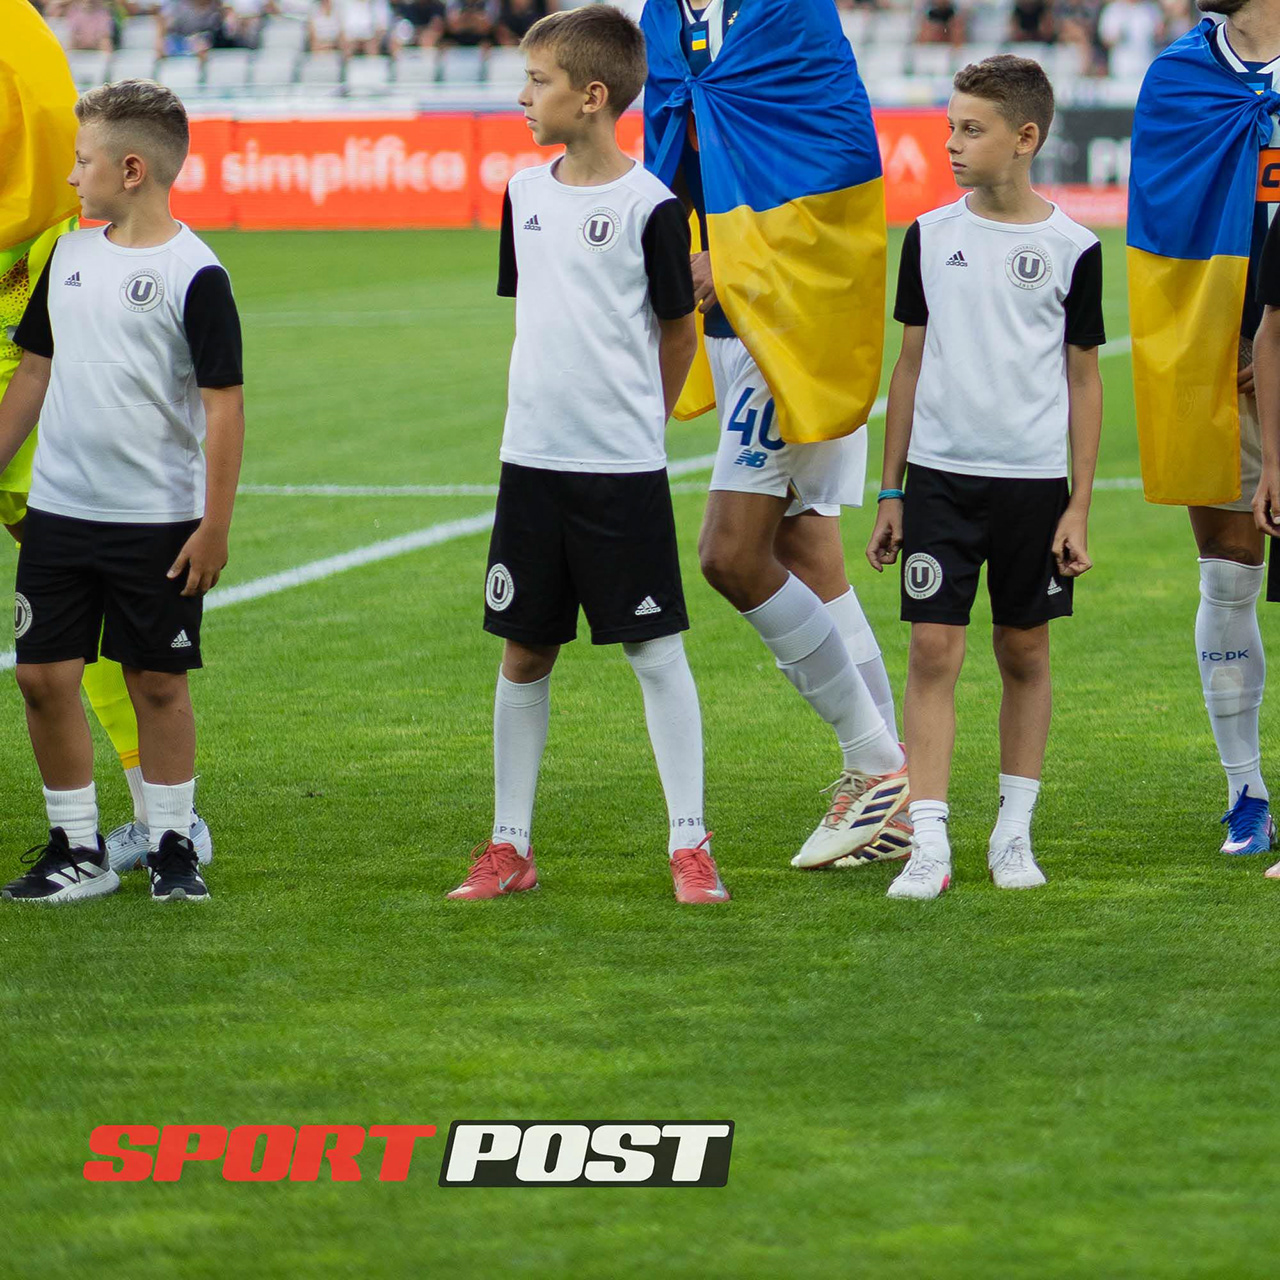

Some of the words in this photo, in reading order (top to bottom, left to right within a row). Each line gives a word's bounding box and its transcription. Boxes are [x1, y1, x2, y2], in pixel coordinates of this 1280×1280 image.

[221, 135, 465, 205] simplifica
[589, 220, 609, 242] U
[1018, 256, 1040, 279] U
[131, 280, 153, 302] U
[493, 575, 505, 600] U
[911, 566, 930, 588] U
[1202, 649, 1249, 661] FCDK
